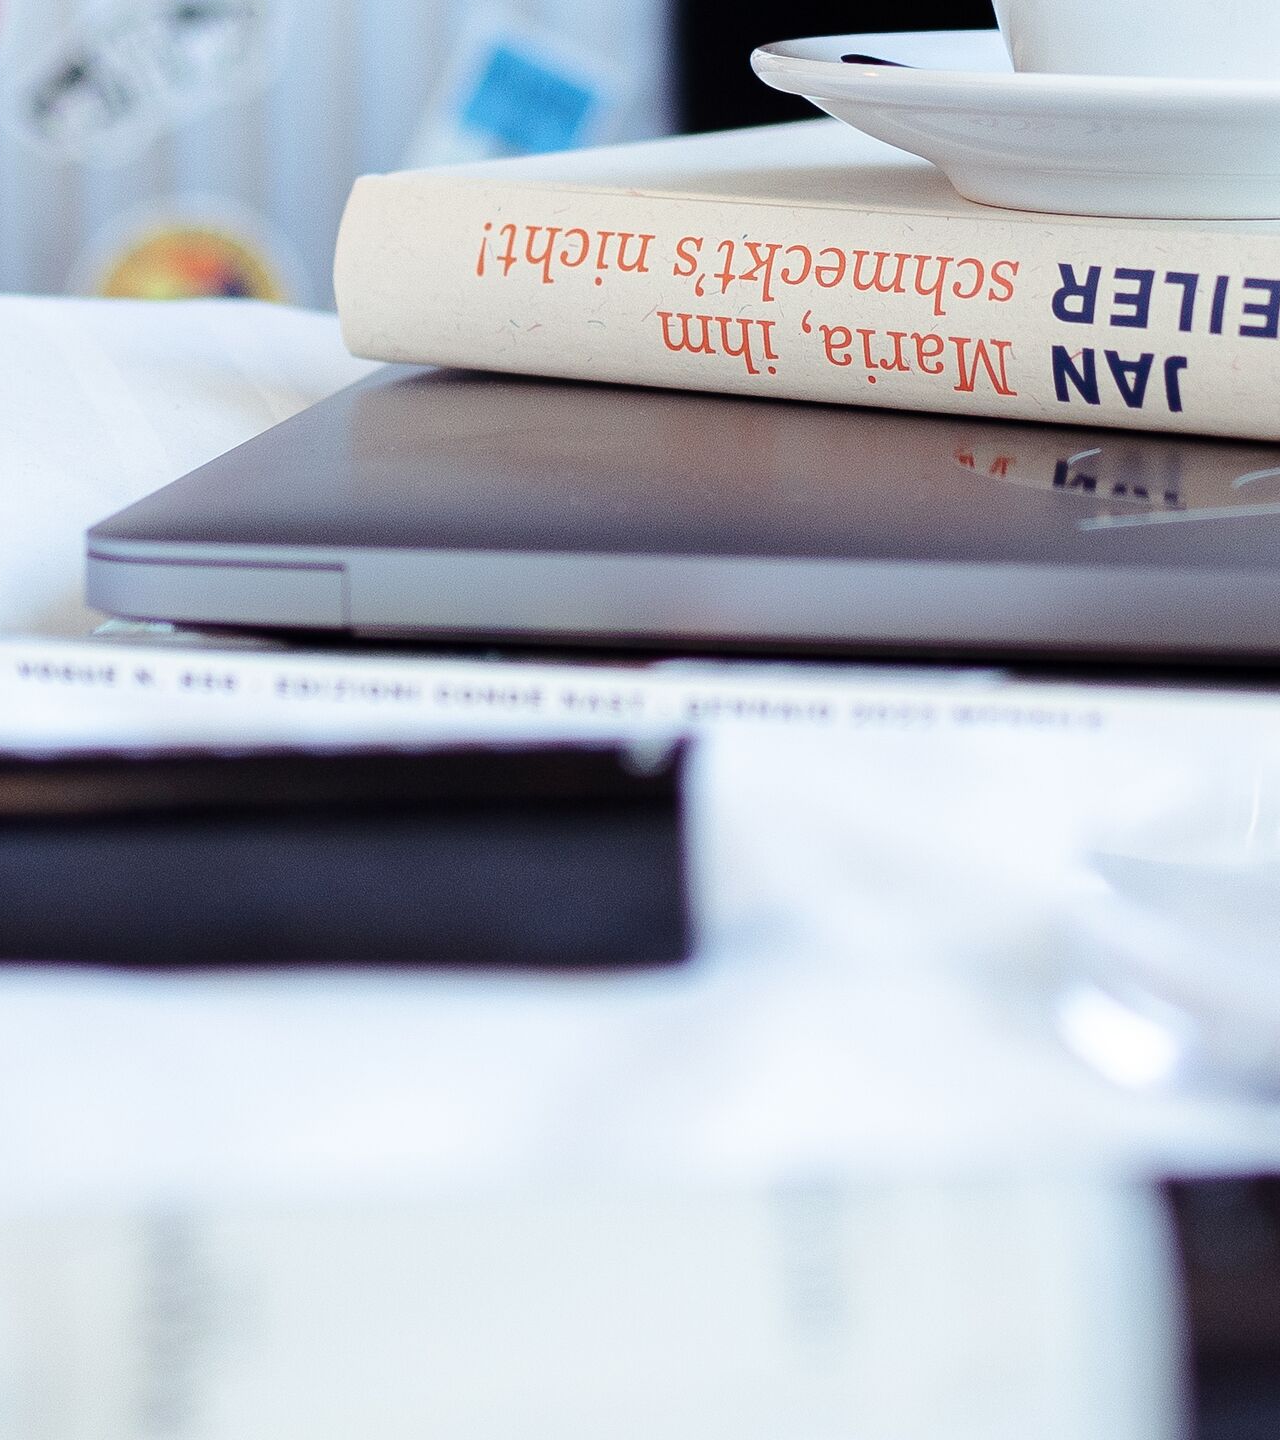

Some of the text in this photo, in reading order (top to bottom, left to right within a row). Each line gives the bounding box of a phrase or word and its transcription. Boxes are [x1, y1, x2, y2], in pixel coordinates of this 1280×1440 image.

[475, 221, 656, 287] nicht!
[656, 309, 1018, 397] Maria, ihm
[1051, 345, 1188, 413] JAN
